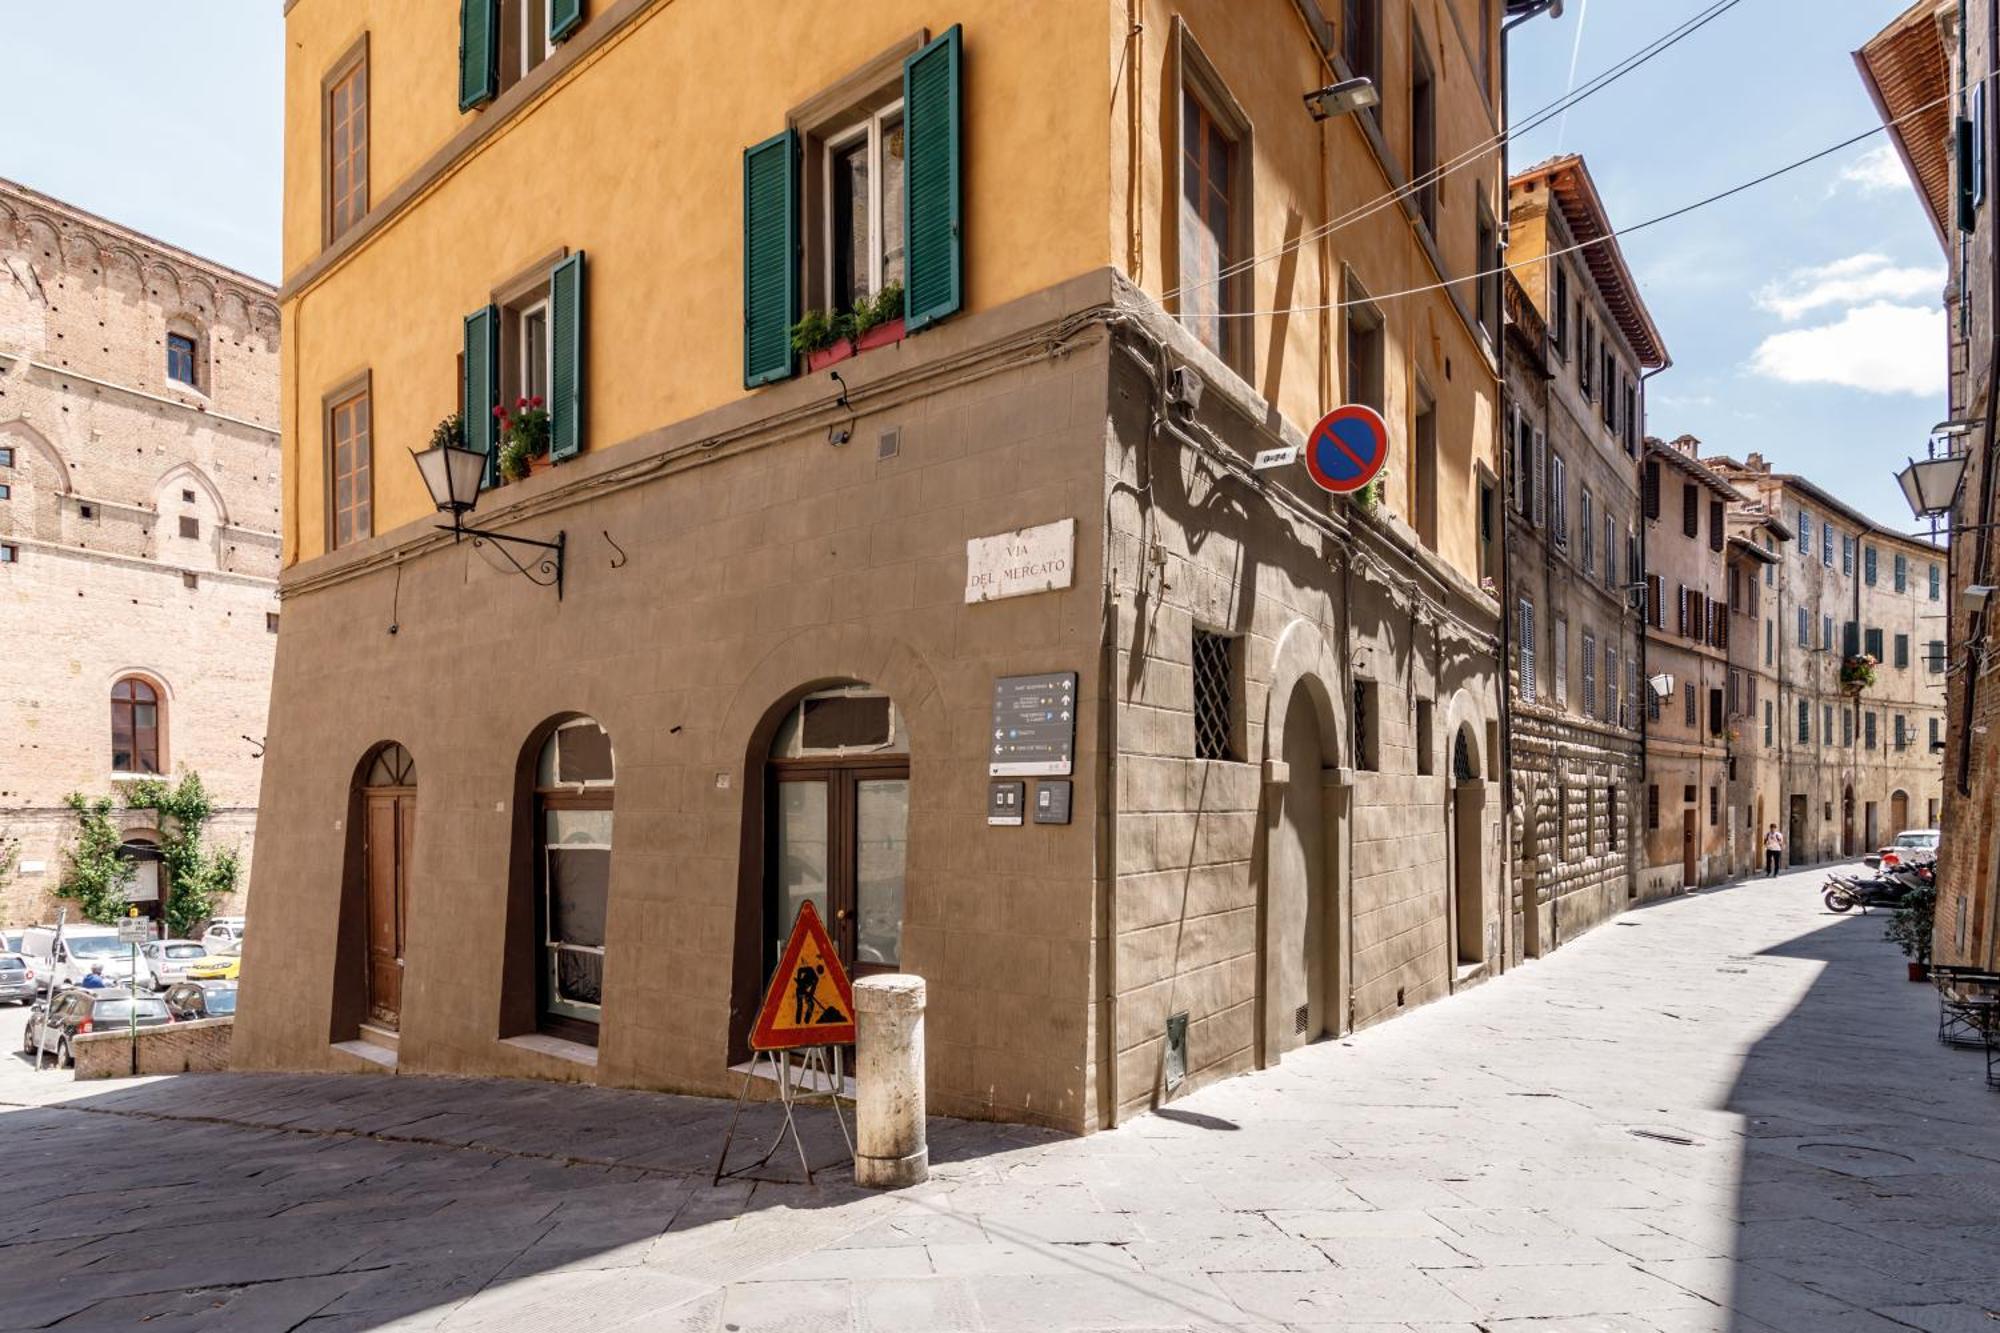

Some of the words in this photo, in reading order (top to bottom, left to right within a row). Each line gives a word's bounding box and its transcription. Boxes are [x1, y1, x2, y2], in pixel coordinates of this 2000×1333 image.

[1006, 544, 1028, 557] VIA
[971, 573, 995, 587] DEL
[1004, 559, 1065, 581] MERCATO
